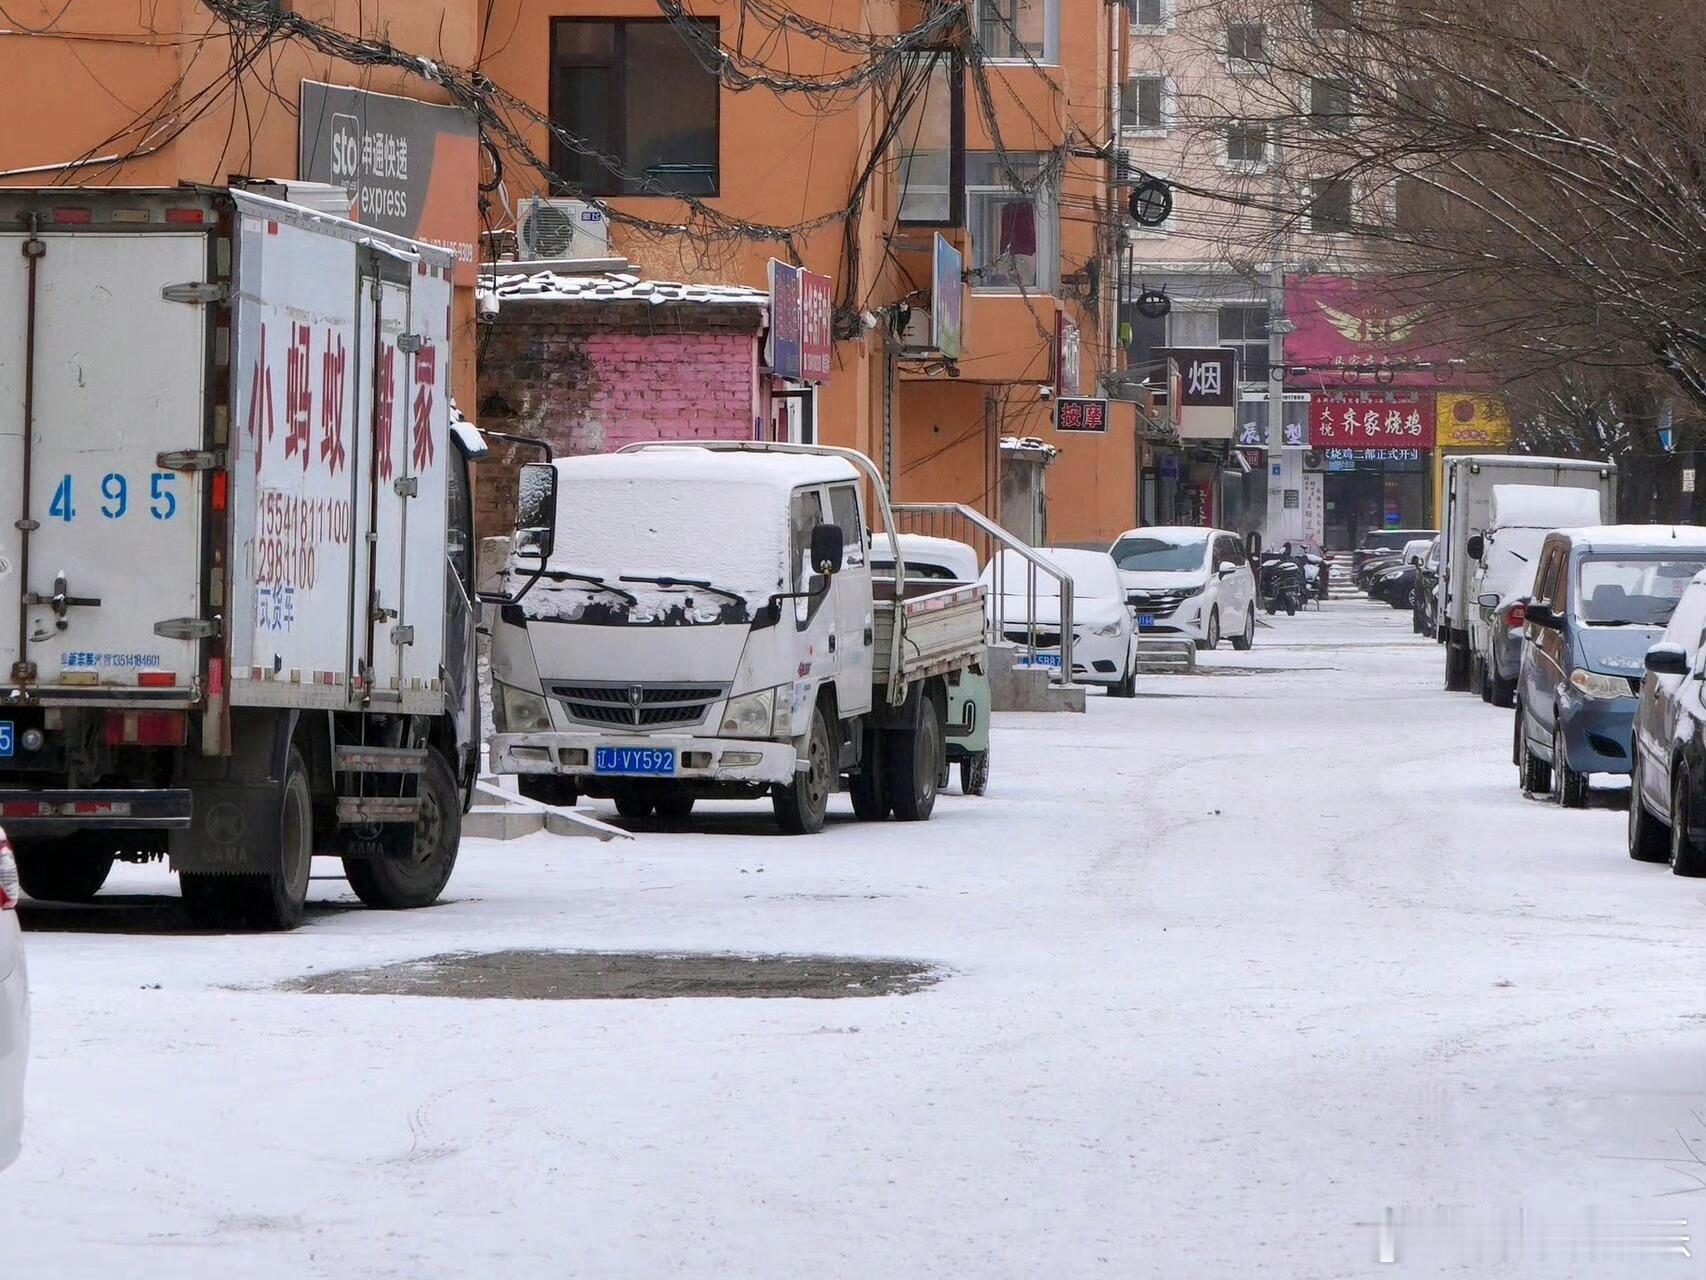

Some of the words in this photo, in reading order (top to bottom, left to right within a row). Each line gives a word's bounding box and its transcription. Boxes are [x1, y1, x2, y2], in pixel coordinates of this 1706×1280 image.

[333, 127, 357, 177] sto
[361, 131, 408, 180] 申通快递
[361, 186, 408, 222] express
[1188, 360, 1222, 396] 烟
[248, 320, 435, 484] 小蚂蚁搬家
[1061, 403, 1103, 428] 按摩
[1240, 421, 1302, 445] 辰型
[1319, 406, 1335, 437] 大悦
[1341, 407, 1423, 437] 齐家烧鸡
